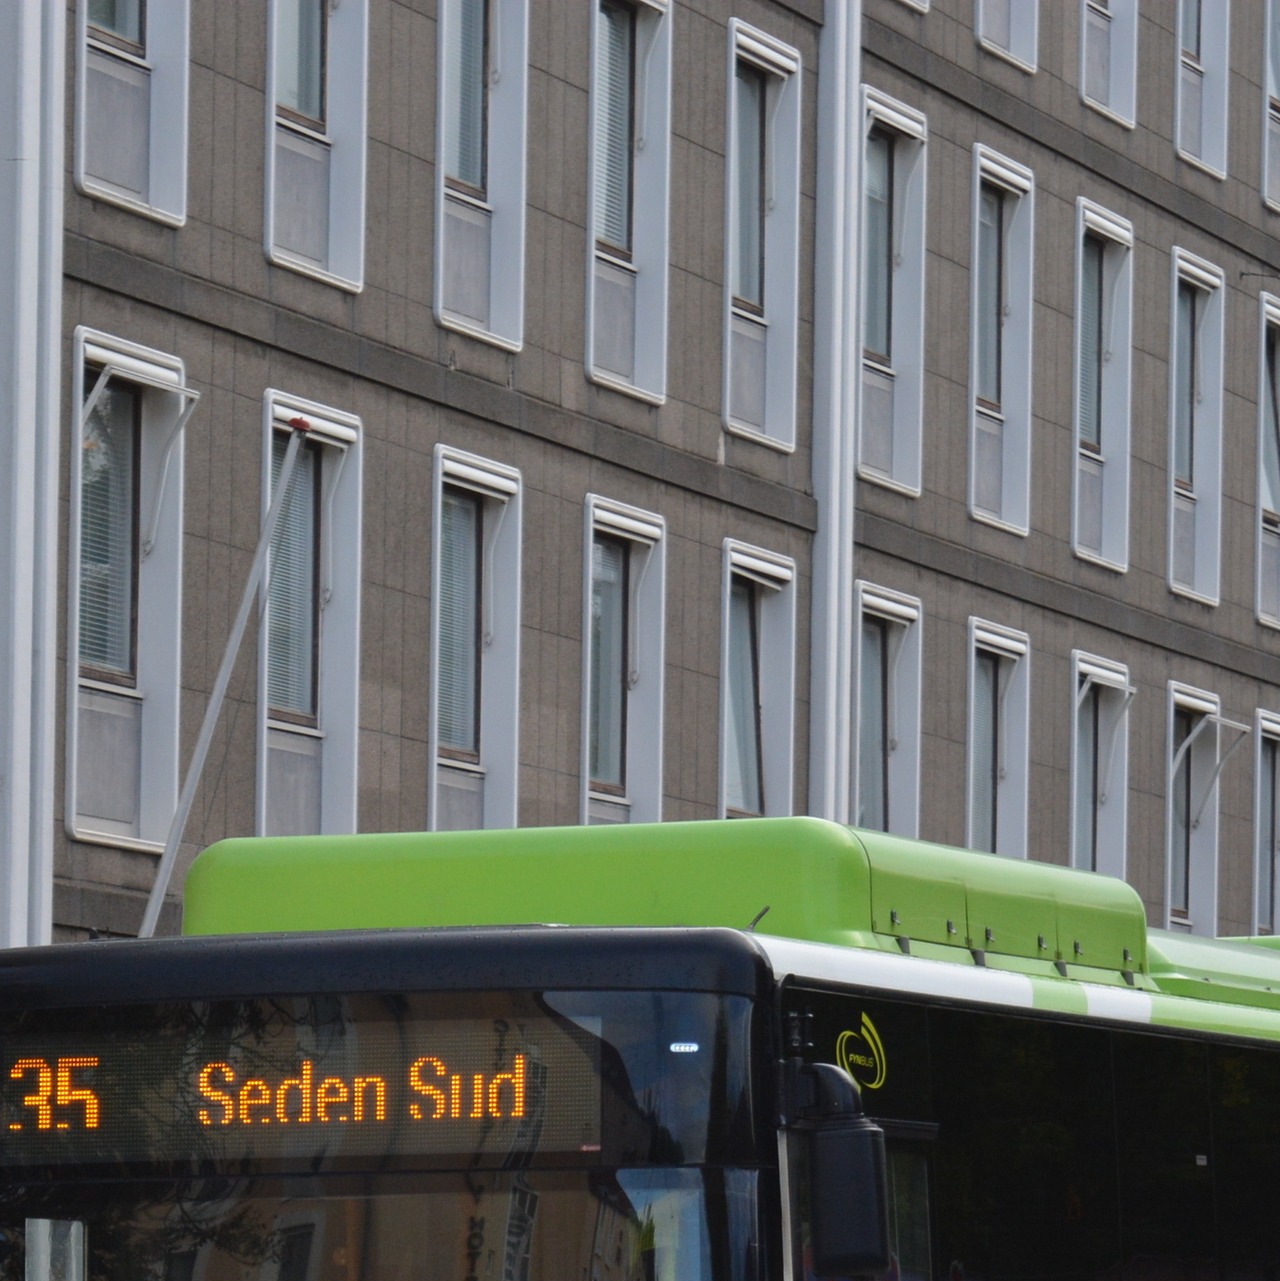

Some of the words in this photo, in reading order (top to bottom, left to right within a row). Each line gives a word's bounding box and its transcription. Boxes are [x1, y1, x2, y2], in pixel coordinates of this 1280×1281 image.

[8, 1056, 100, 1131] 35
[197, 1060, 387, 1127] Seden
[408, 1053, 526, 1121] Sud
